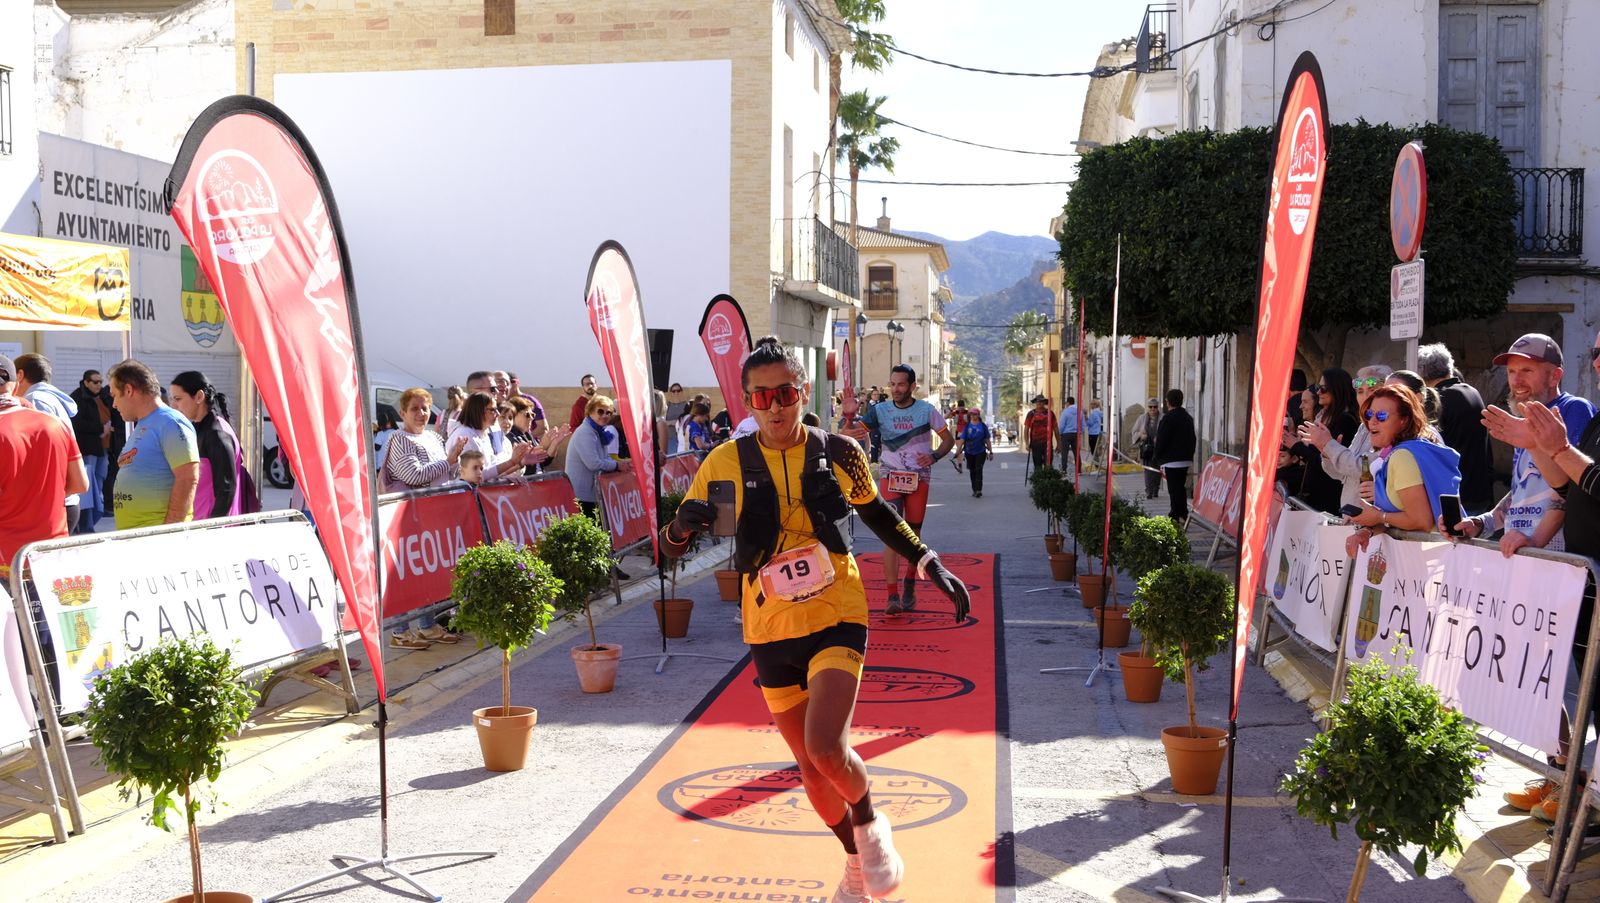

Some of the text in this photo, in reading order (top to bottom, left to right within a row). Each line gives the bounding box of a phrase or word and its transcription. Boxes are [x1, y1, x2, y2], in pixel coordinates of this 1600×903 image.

[54, 171, 170, 216] EXCELENTÍSIM
[57, 211, 170, 251] AYUNTAMIENTO
[130, 297, 155, 321] RIA
[894, 476, 913, 485] 112
[620, 489, 644, 521] VEOL
[385, 525, 467, 581] VEOLIA
[1322, 559, 1344, 576] DE
[119, 553, 312, 600] AYUNTAMIENTO DE
[779, 559, 811, 581] 19
[123, 576, 324, 652] CANTORIA
[1534, 608, 1558, 637] DE
[1380, 604, 1554, 700] CANTORIA
[661, 873, 825, 890] Cantoria
